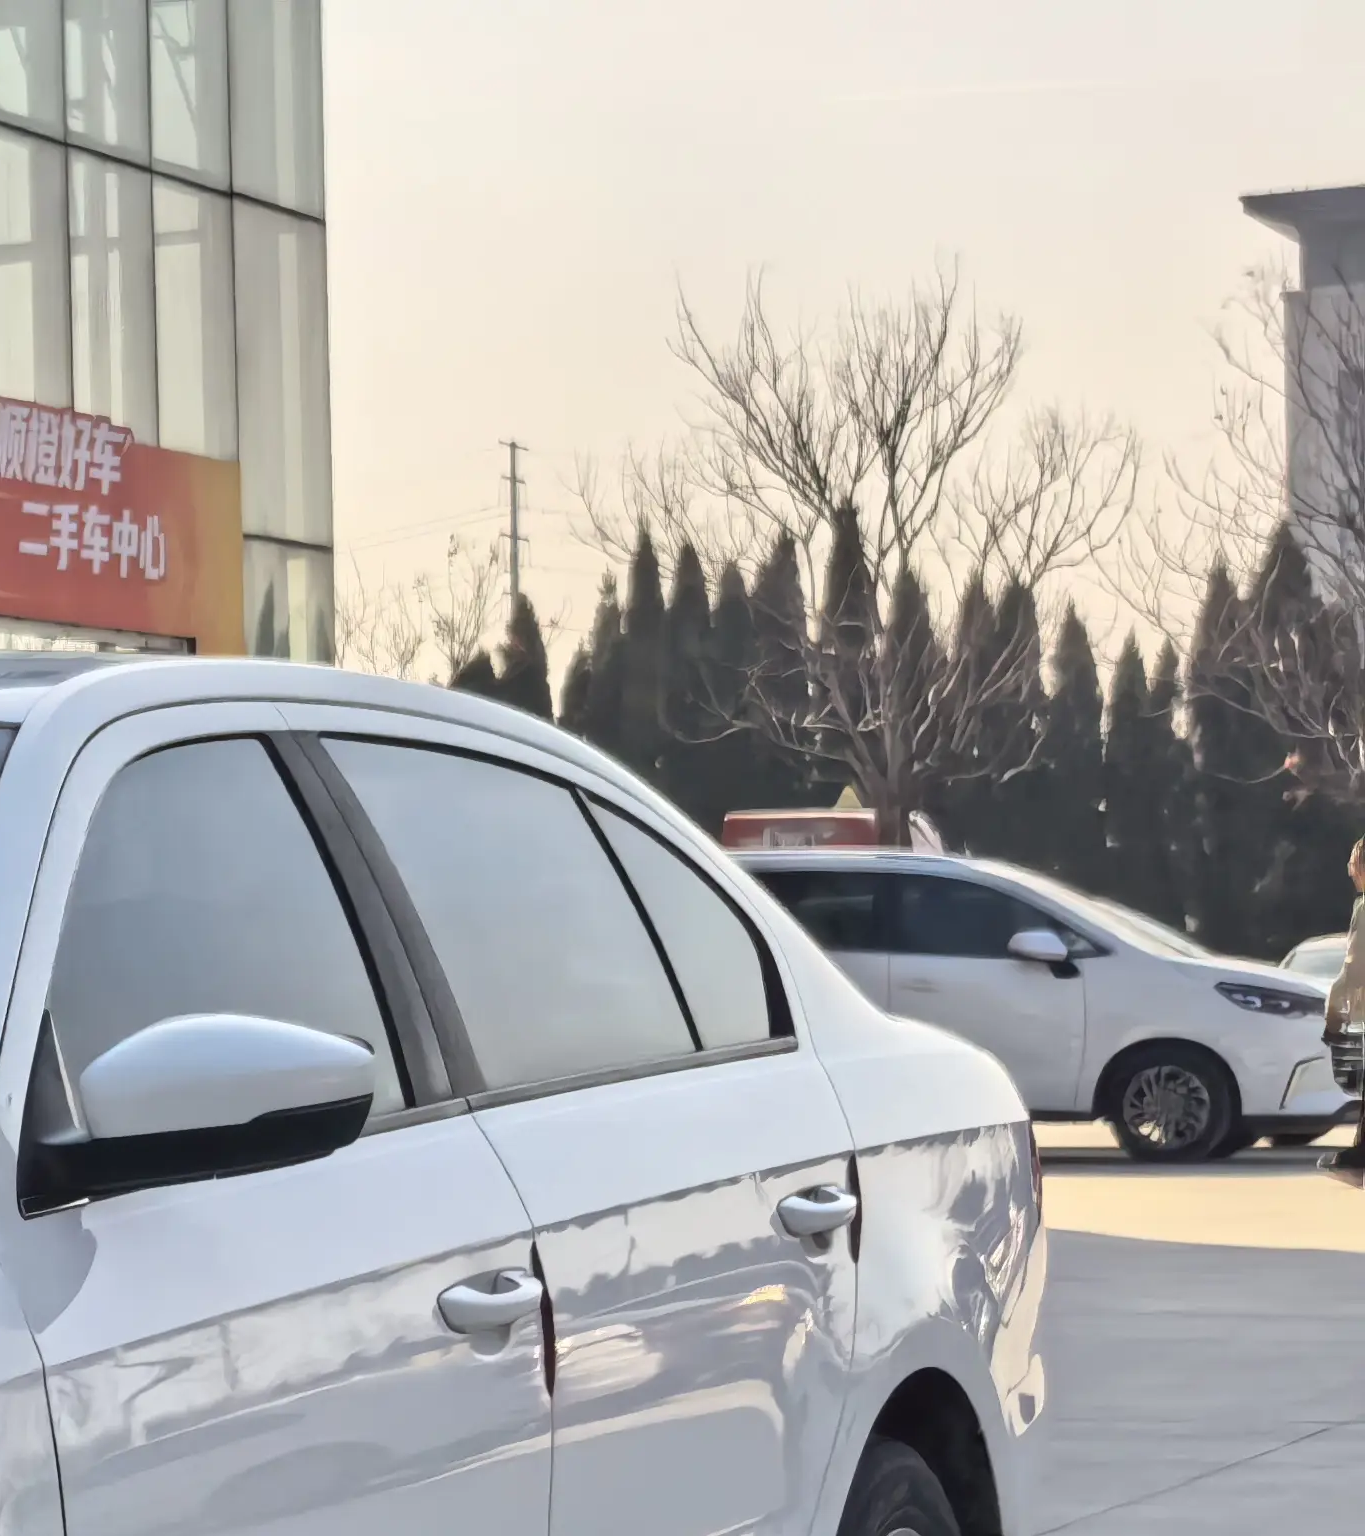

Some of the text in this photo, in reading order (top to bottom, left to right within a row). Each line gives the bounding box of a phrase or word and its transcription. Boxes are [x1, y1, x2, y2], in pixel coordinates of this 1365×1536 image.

[18, 501, 165, 580] 二手车中心
